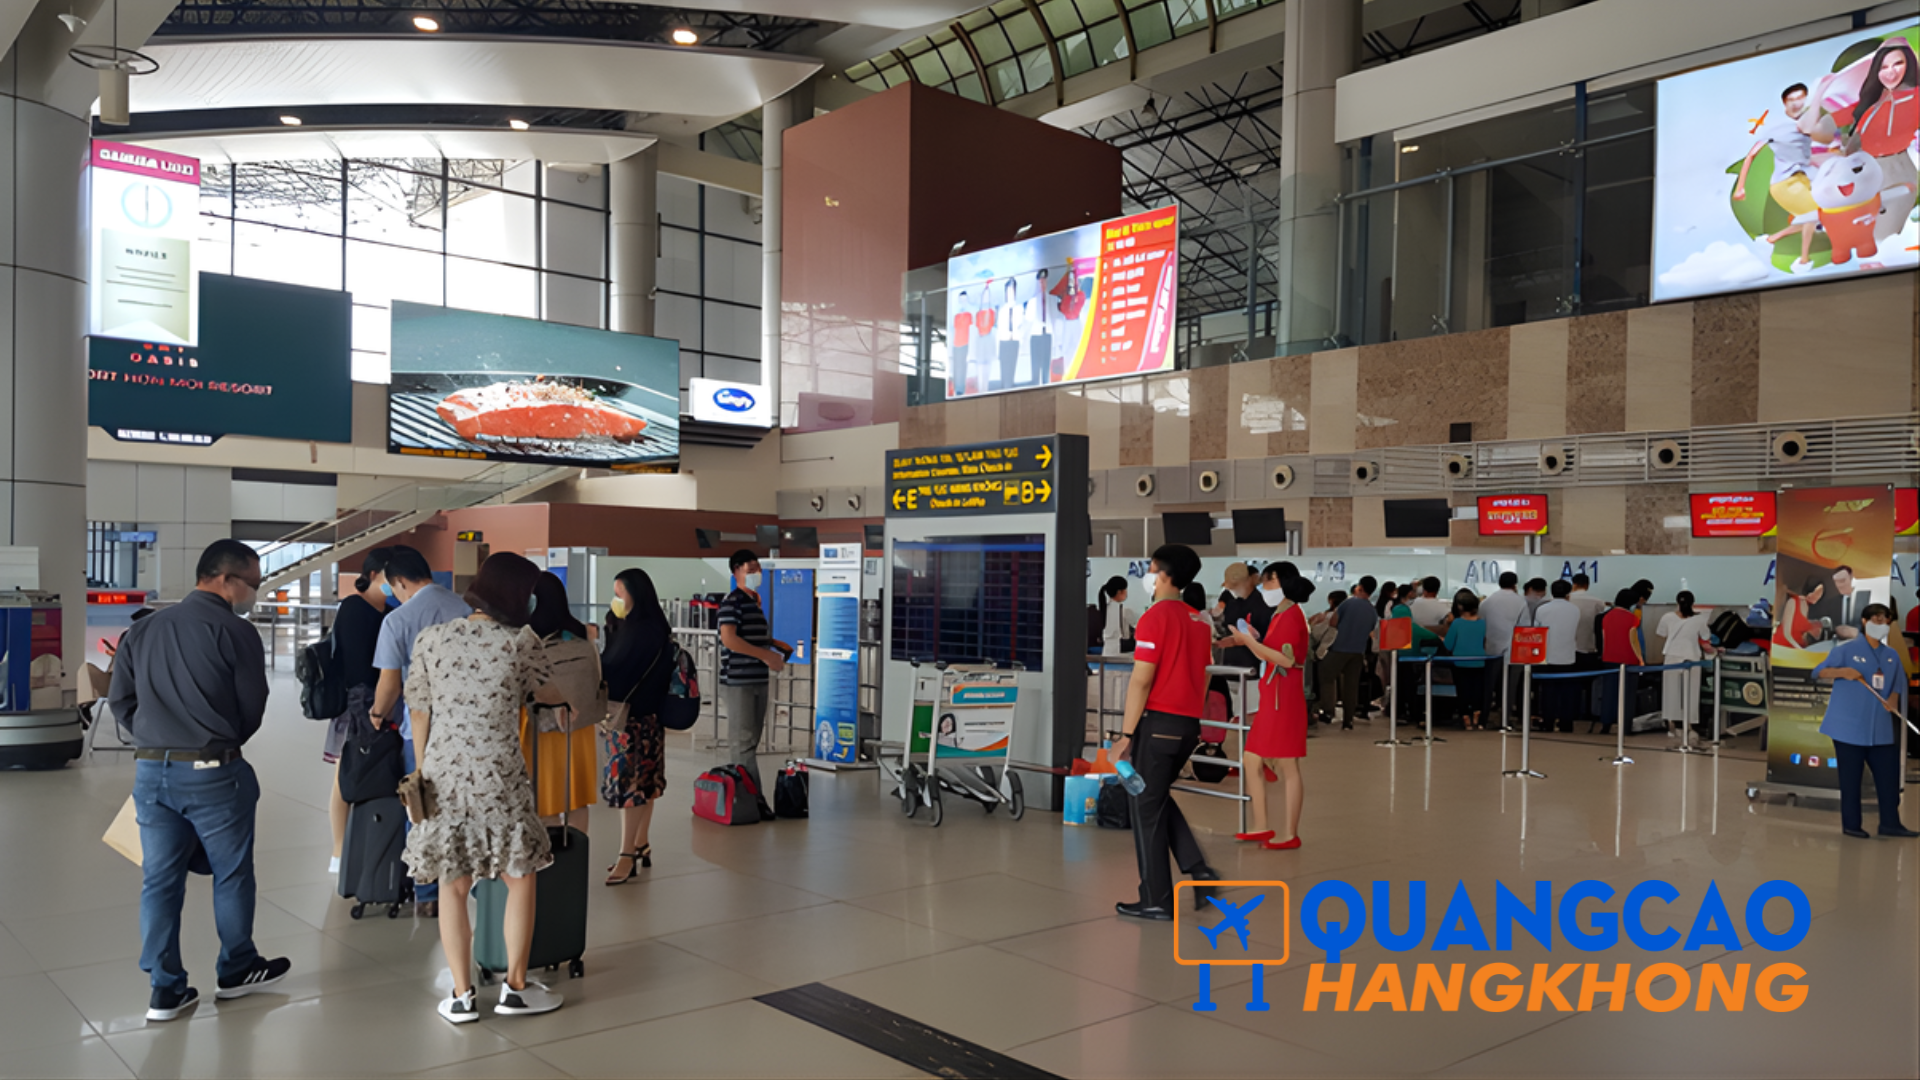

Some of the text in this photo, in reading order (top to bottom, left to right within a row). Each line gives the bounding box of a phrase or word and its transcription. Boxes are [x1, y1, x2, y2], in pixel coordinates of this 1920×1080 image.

[906, 488, 918, 510] E
[1021, 480, 1034, 504] B
[1465, 559, 1500, 583] A10
